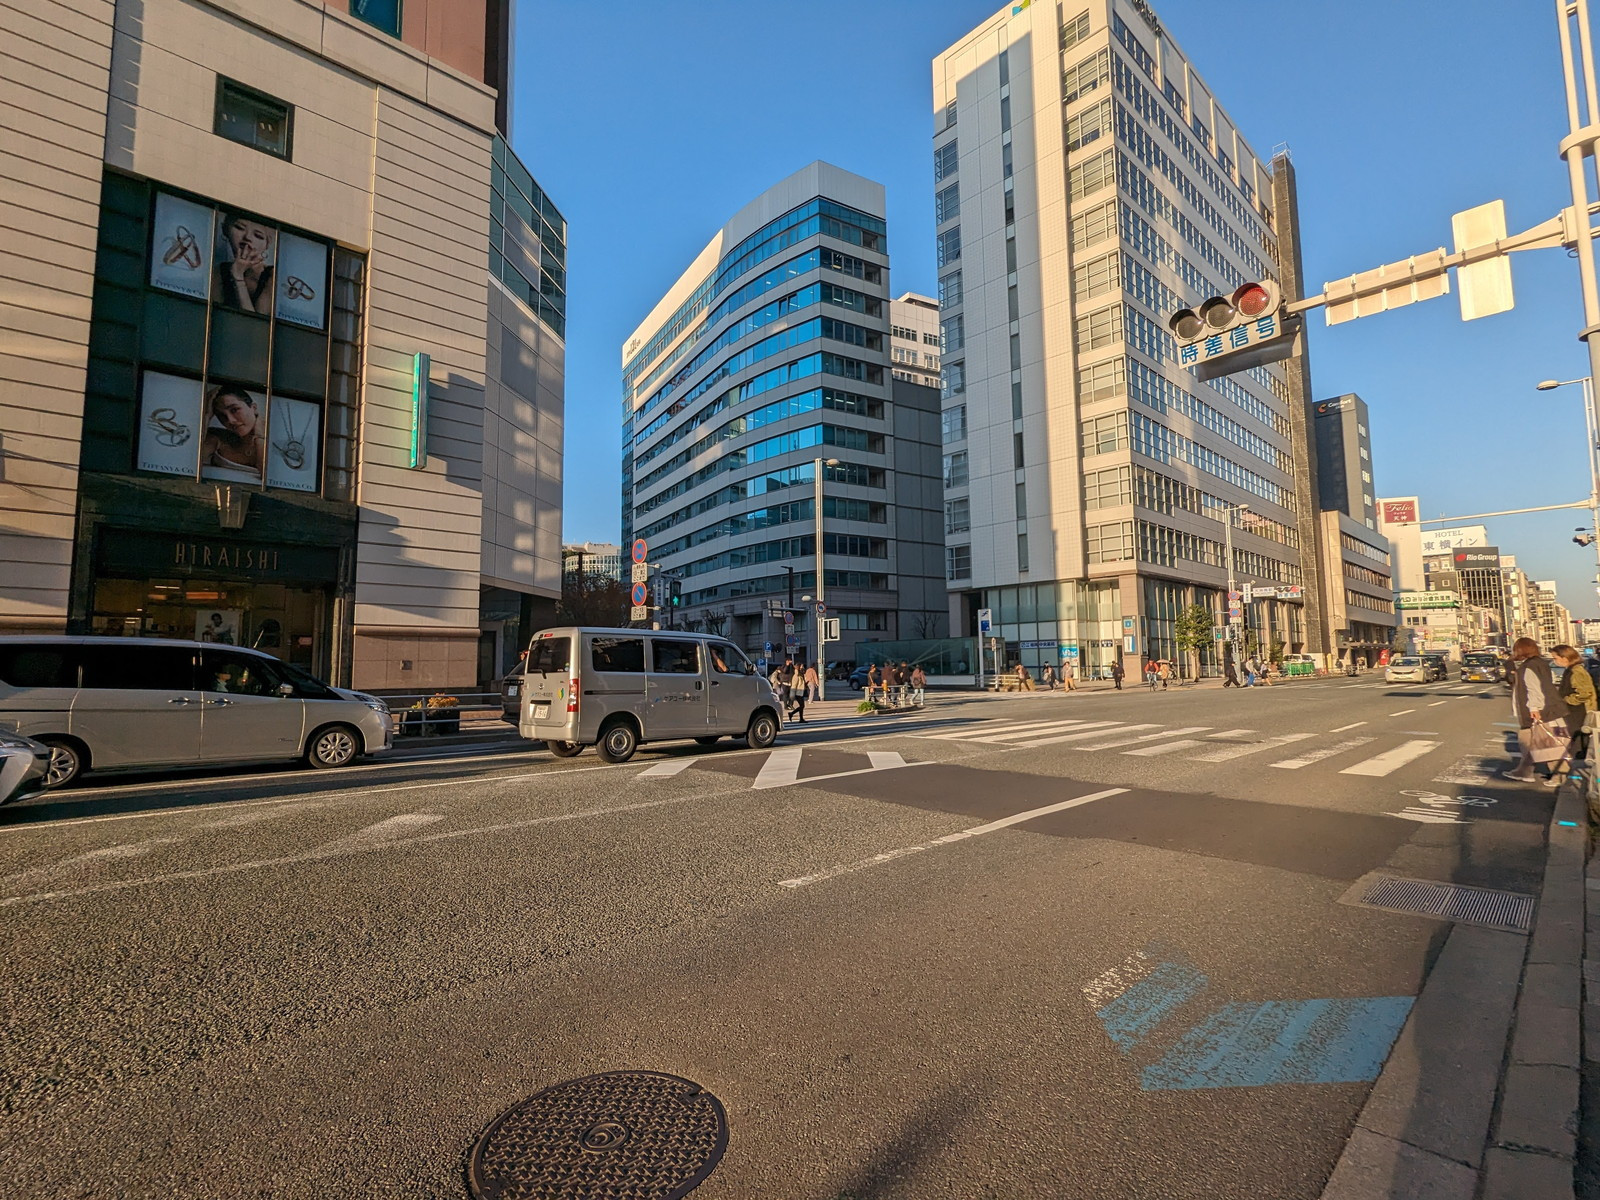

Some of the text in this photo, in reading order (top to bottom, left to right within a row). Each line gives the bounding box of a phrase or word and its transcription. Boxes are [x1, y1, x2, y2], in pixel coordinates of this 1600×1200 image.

[1181, 316, 1275, 365] 時差信号
[1385, 503, 1413, 512] Felio
[1434, 530, 1463, 538] HOTEL
[1423, 538, 1478, 551] 東横イン
[175, 543, 278, 570] HIRAISHI
